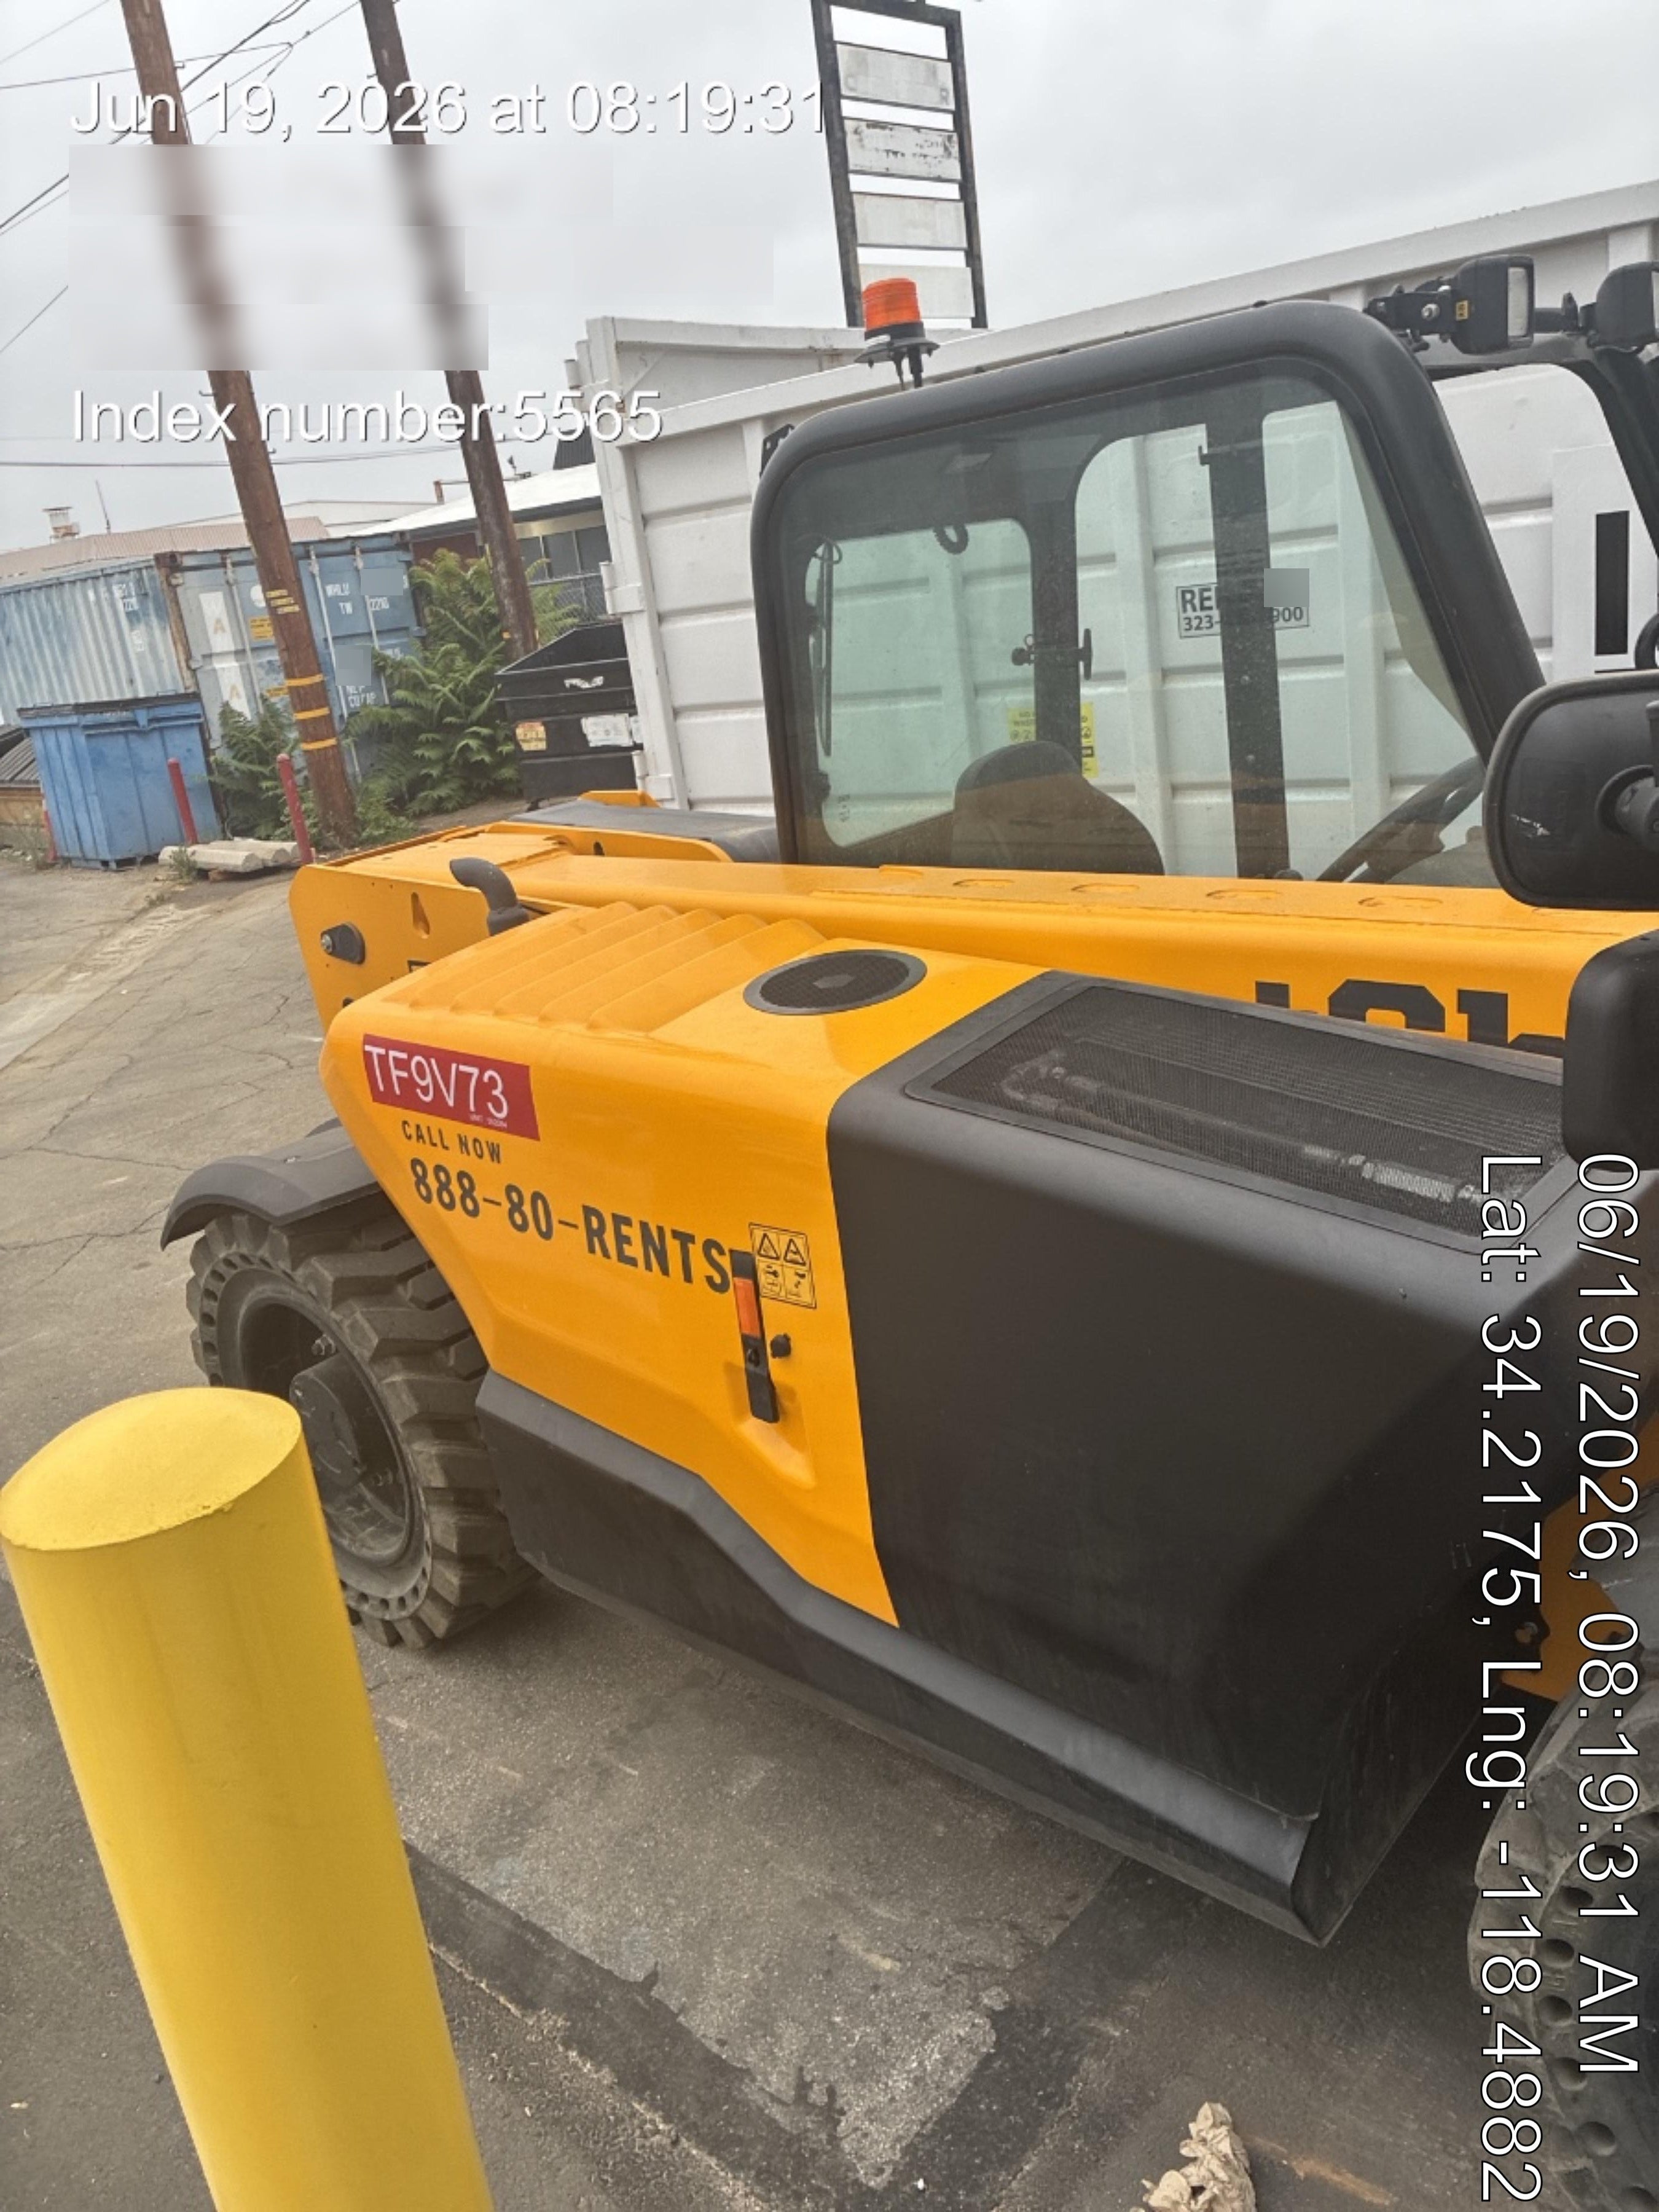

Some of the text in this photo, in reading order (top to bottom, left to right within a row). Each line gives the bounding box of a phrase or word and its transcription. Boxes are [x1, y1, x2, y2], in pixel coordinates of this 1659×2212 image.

[364, 1045, 509, 1119] TF9V73
[401, 1120, 450, 1150] CALL
[457, 1133, 501, 1164] NOW
[410, 1158, 731, 1295] 888-80-RENTS
